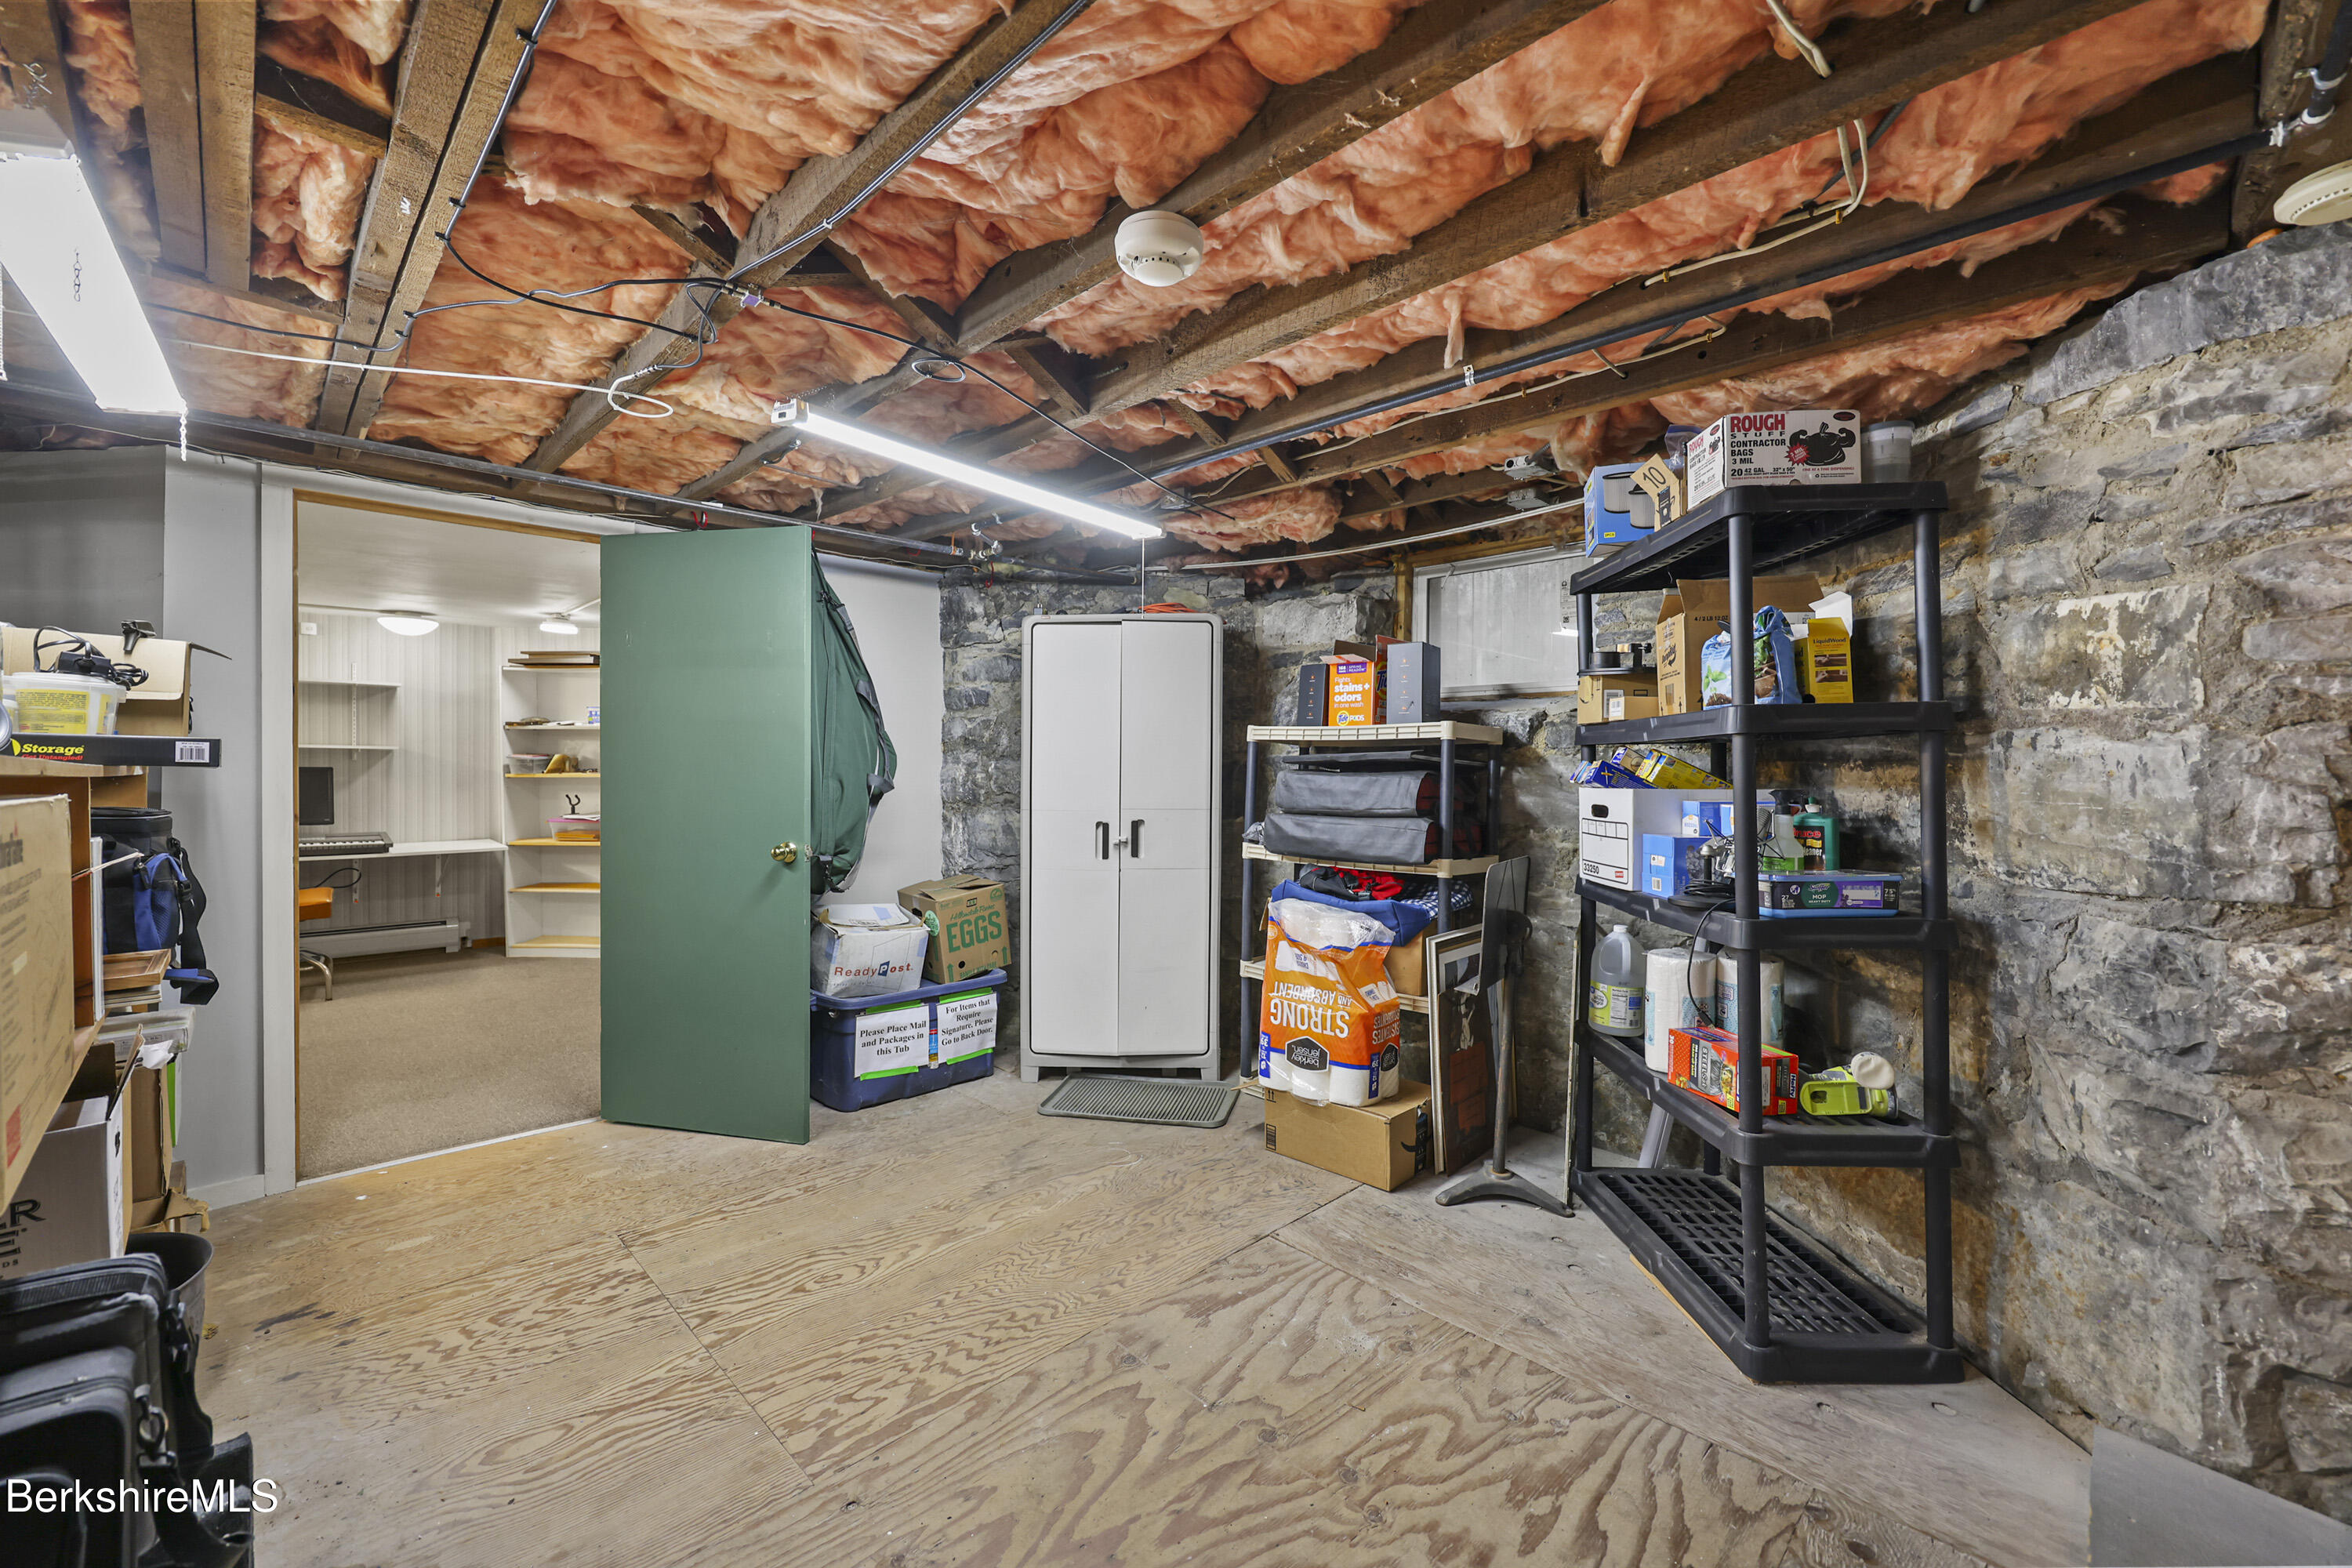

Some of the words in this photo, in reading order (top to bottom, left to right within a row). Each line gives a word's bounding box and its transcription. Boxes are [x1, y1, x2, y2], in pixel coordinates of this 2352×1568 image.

[1730, 413, 1786, 433] ROUGH
[1730, 439, 1787, 448] CONTRACTOR
[1730, 448, 1754, 457] BAGS
[1642, 466, 1666, 488] 10
[1730, 468, 1743, 477] 20
[1377, 671, 1387, 692] Ti
[1334, 683, 1363, 693] stains
[1334, 692, 1362, 702] odors
[1338, 714, 1348, 724] Tide
[21, 743, 84, 756] Storage
[1803, 848, 1823, 857] leaner
[1583, 862, 1599, 875] 33250
[946, 910, 1002, 953] EGGS
[1273, 981, 1337, 1006] ABSORBENT
[1338, 995, 1352, 1006] AND
[946, 1006, 958, 1014] For
[960, 1002, 977, 1011] Items
[956, 1011, 981, 1022] Require
[975, 1018, 994, 1027] Please
[1270, 998, 1349, 1038] STRONG
[860, 1028, 884, 1038] Please
[887, 1025, 908, 1033] Place
[909, 1021, 927, 1030] Mail
[960, 1031, 975, 1041] Back
[977, 1026, 993, 1036] Door.
[861, 1039, 877, 1047] and
[879, 1035, 914, 1047] Packages
[877, 1047, 891, 1056] this
[1290, 1053, 1319, 1068] berkley
[0, 1199, 46, 1228] R
